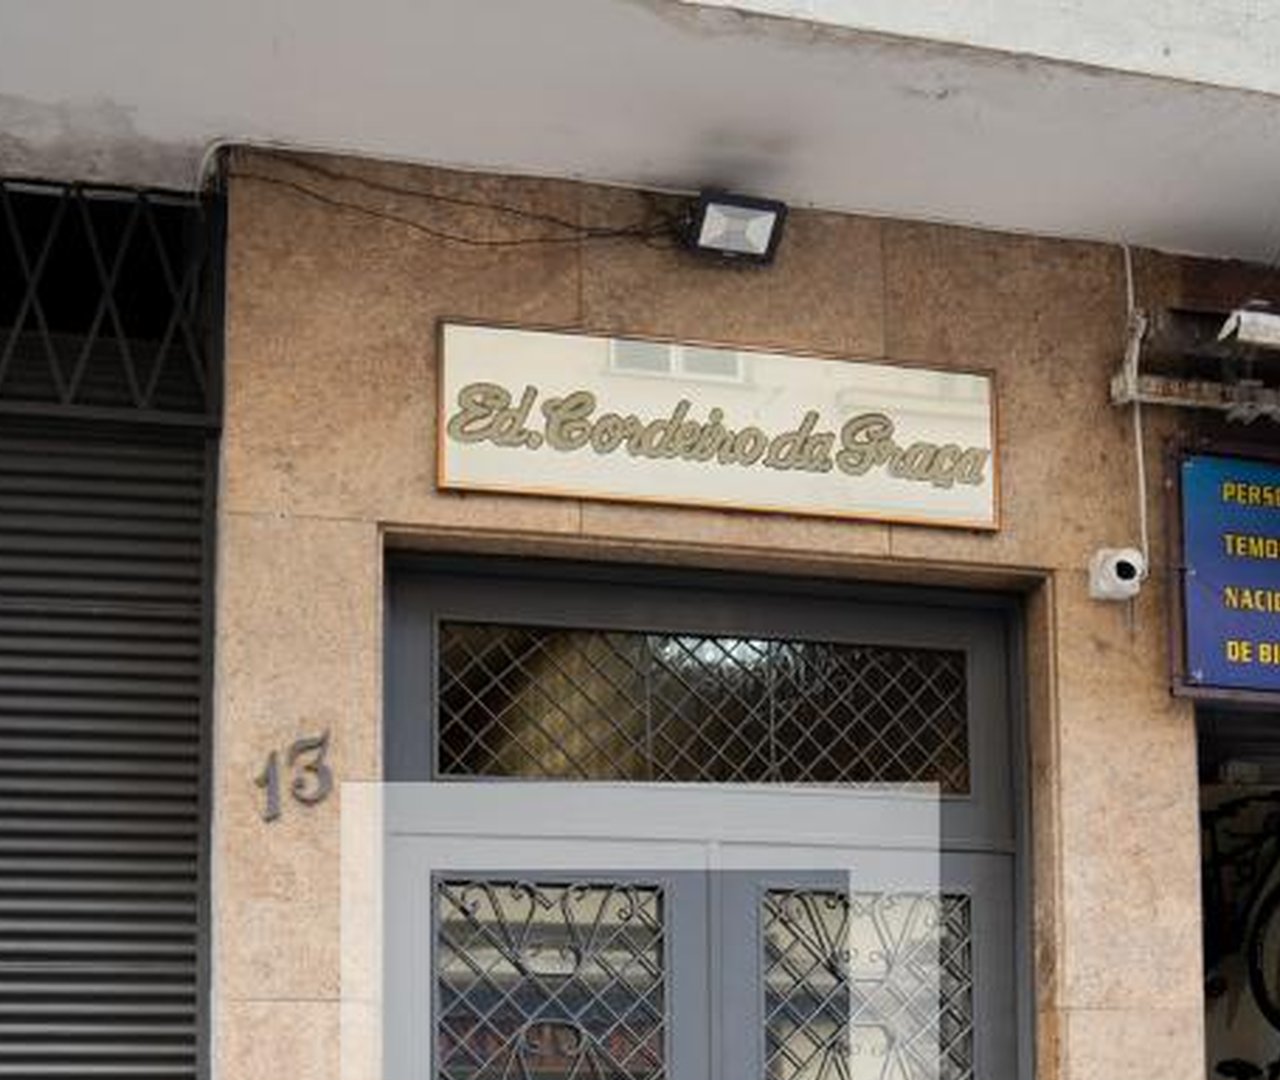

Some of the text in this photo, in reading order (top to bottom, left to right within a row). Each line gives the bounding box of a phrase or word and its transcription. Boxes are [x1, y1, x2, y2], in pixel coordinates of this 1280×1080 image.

[447, 382, 542, 450] Ed.
[542, 390, 763, 466] Cordeiro
[763, 410, 833, 474] da
[1226, 640, 1252, 662] DE
[254, 727, 334, 824] 13
